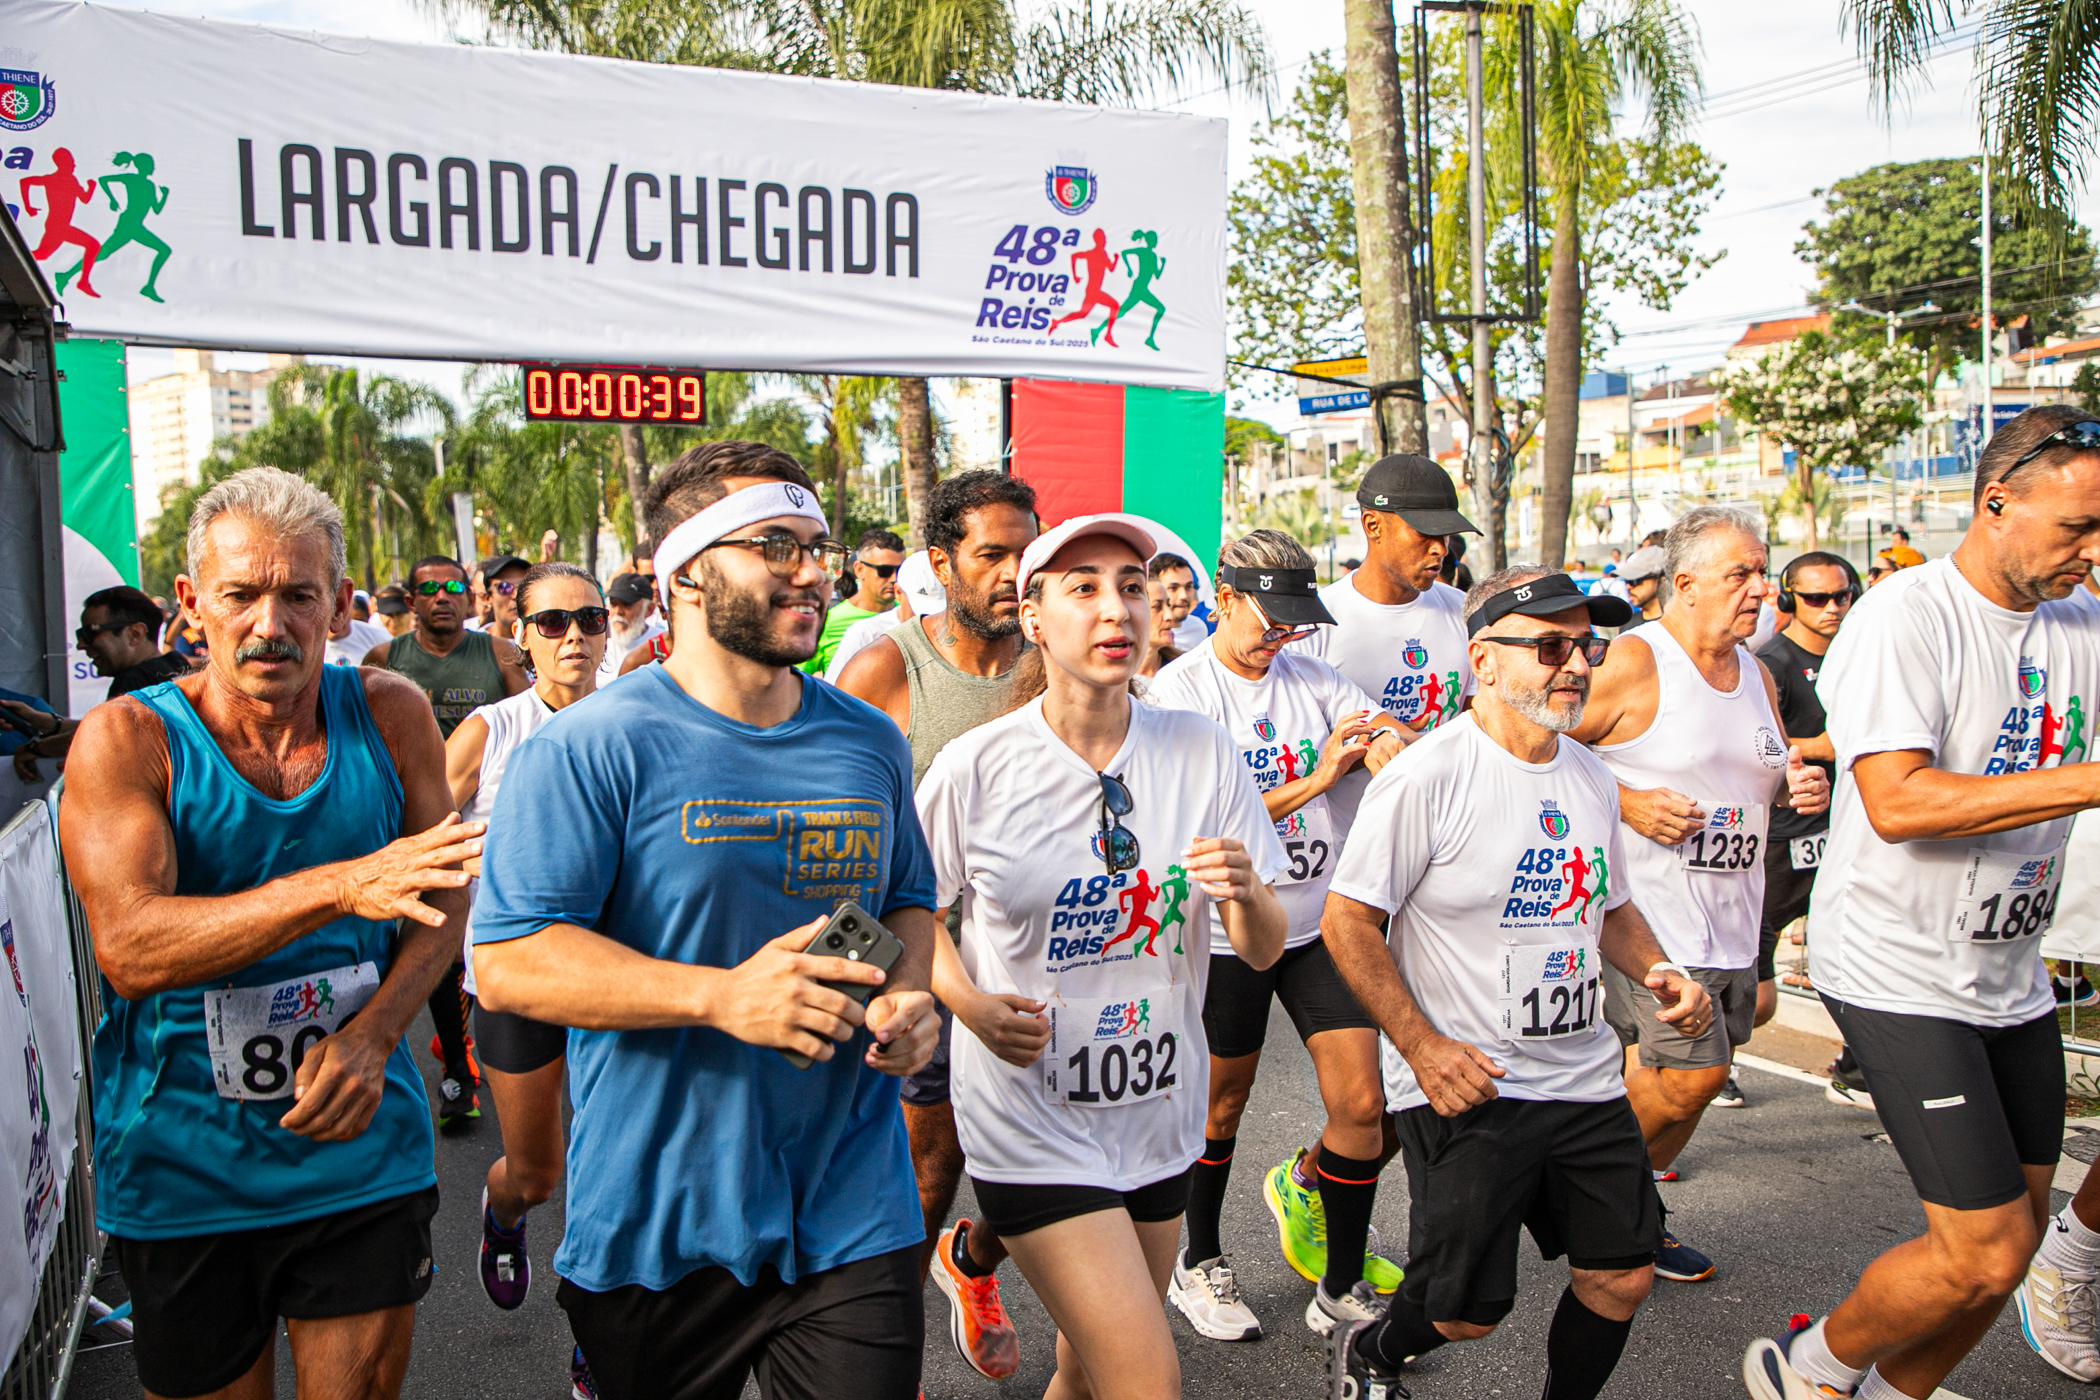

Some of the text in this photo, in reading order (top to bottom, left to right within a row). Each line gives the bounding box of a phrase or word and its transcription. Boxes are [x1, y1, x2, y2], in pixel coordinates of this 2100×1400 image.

[2, 71, 37, 83] THIENE
[238, 138, 919, 278] LARGADA/CHEGADA
[985, 264, 1069, 294] Prova
[1048, 295, 1065, 306] de
[975, 297, 1051, 330] Reis
[992, 336, 1033, 345] Caetano
[528, 370, 700, 420] 00:00:39
[1311, 396, 1335, 409] RUA
[1337, 394, 1352, 407] DE
[443, 688, 487, 703] ALVO
[1381, 697, 1420, 710] Prova
[1993, 735, 2040, 753] Prova
[1253, 770, 1279, 783] ova
[713, 812, 771, 827] Santander
[800, 830, 880, 861] RUN
[1688, 831, 1758, 869] 1233
[798, 862, 878, 880] SERIES
[803, 884, 861, 899] SHOPPING
[1510, 876, 1562, 893] Prova
[1502, 895, 1552, 918] Reis
[1971, 882, 2061, 940] 1884
[1051, 908, 1119, 932] Prova
[1102, 925, 1115, 934] de
[1048, 929, 1105, 960] Reis
[1060, 961, 1089, 972] Caetano
[1090, 958, 1100, 966] do
[1522, 977, 1597, 1036] 1217
[1068, 1032, 1176, 1102] 1032
